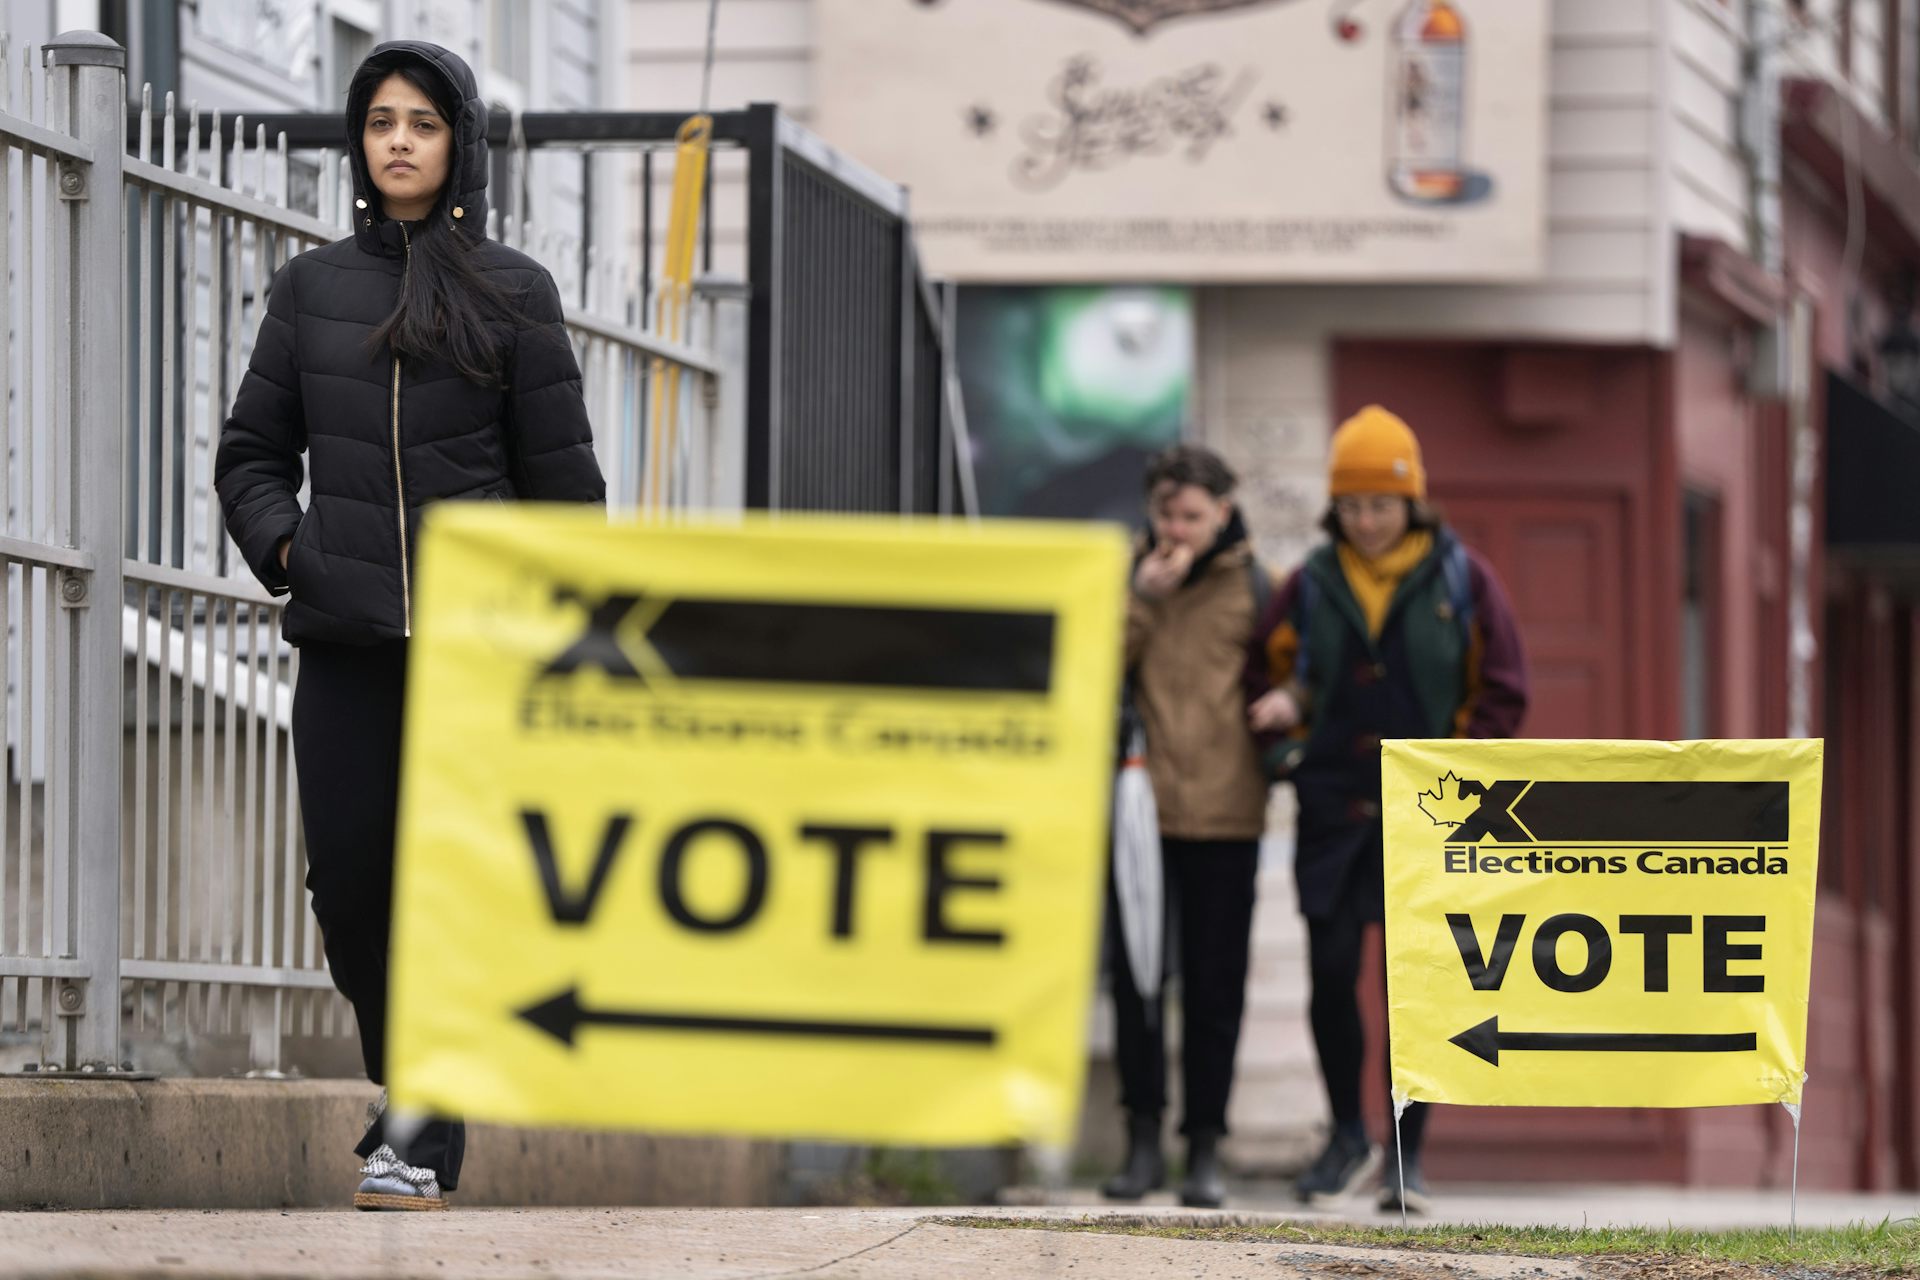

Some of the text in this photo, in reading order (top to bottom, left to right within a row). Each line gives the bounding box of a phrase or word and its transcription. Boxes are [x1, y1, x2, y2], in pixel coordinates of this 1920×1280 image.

[517, 807, 1009, 949] VOTE
[1444, 846, 1789, 875] Elections Canada
[1445, 913, 1766, 994] VOTE
